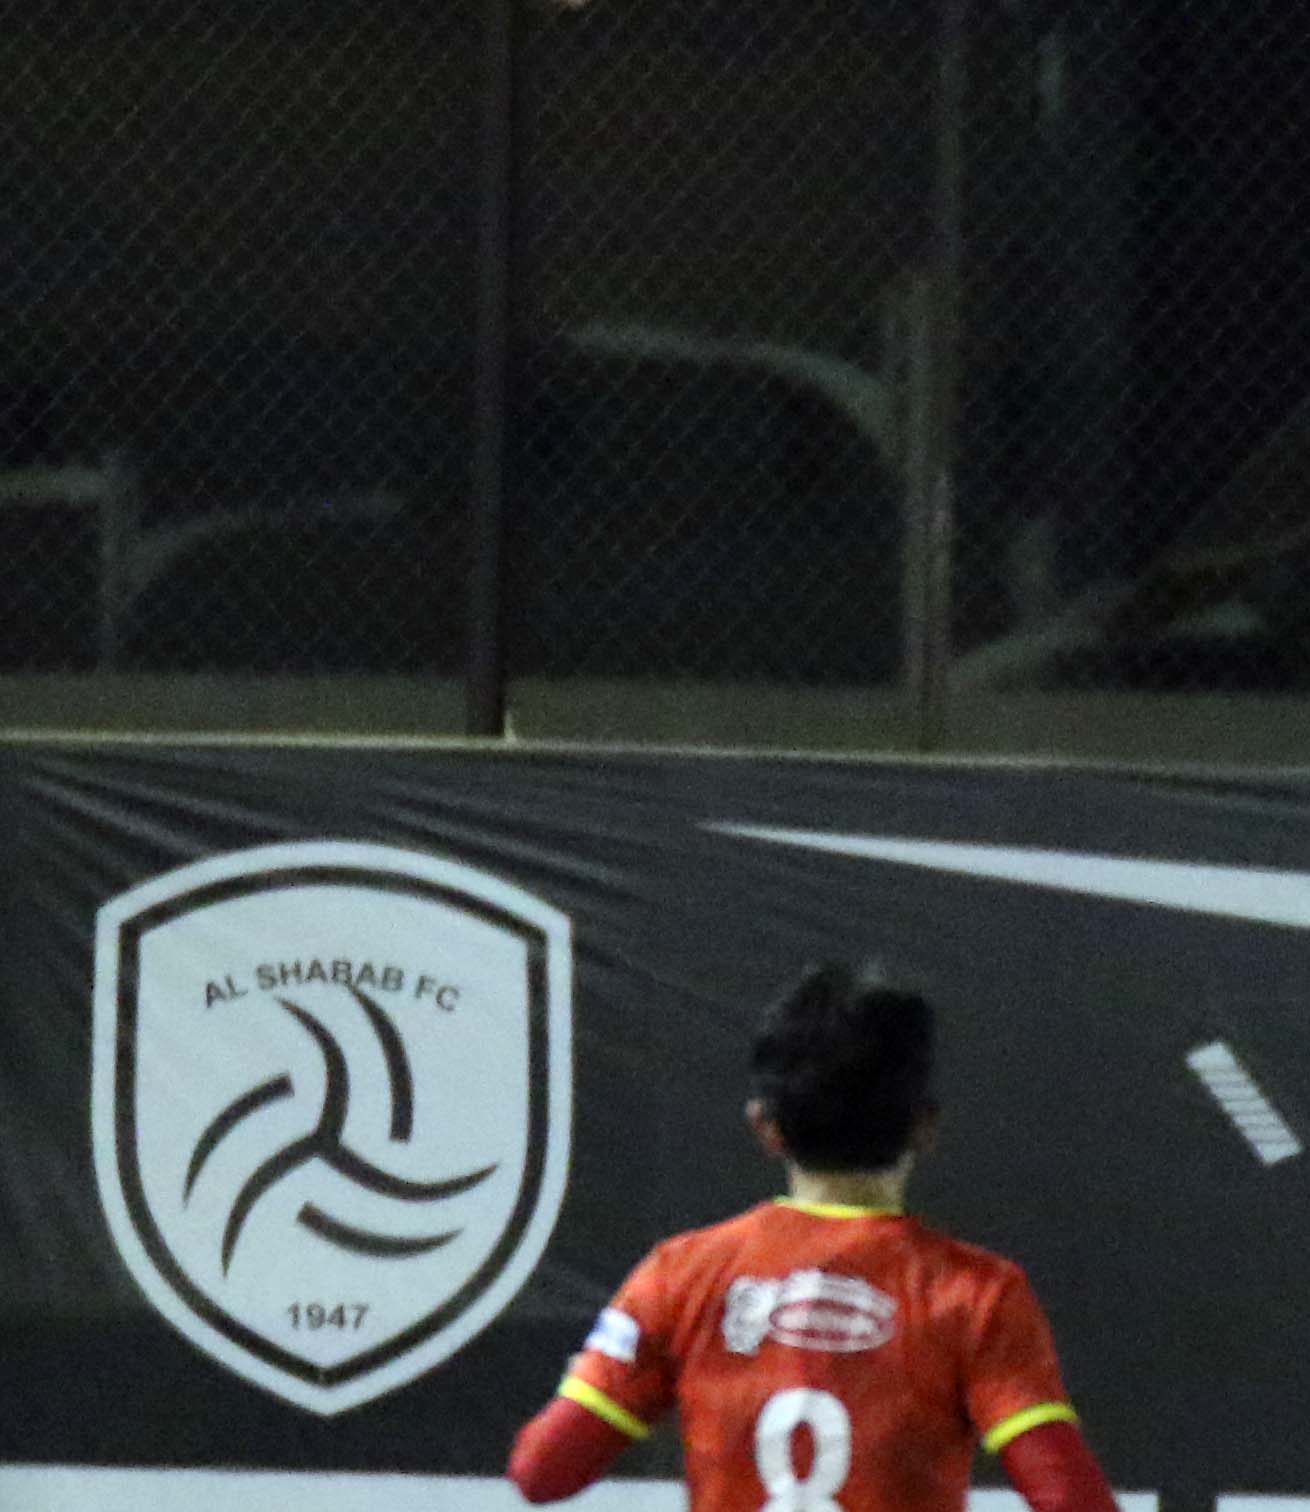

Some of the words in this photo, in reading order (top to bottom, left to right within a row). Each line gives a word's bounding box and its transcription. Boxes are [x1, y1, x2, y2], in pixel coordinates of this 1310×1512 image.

[203, 974, 248, 1009] AL
[255, 958, 405, 994] SHABAB
[413, 976, 461, 1013] FC
[286, 1302, 371, 1332] 1947
